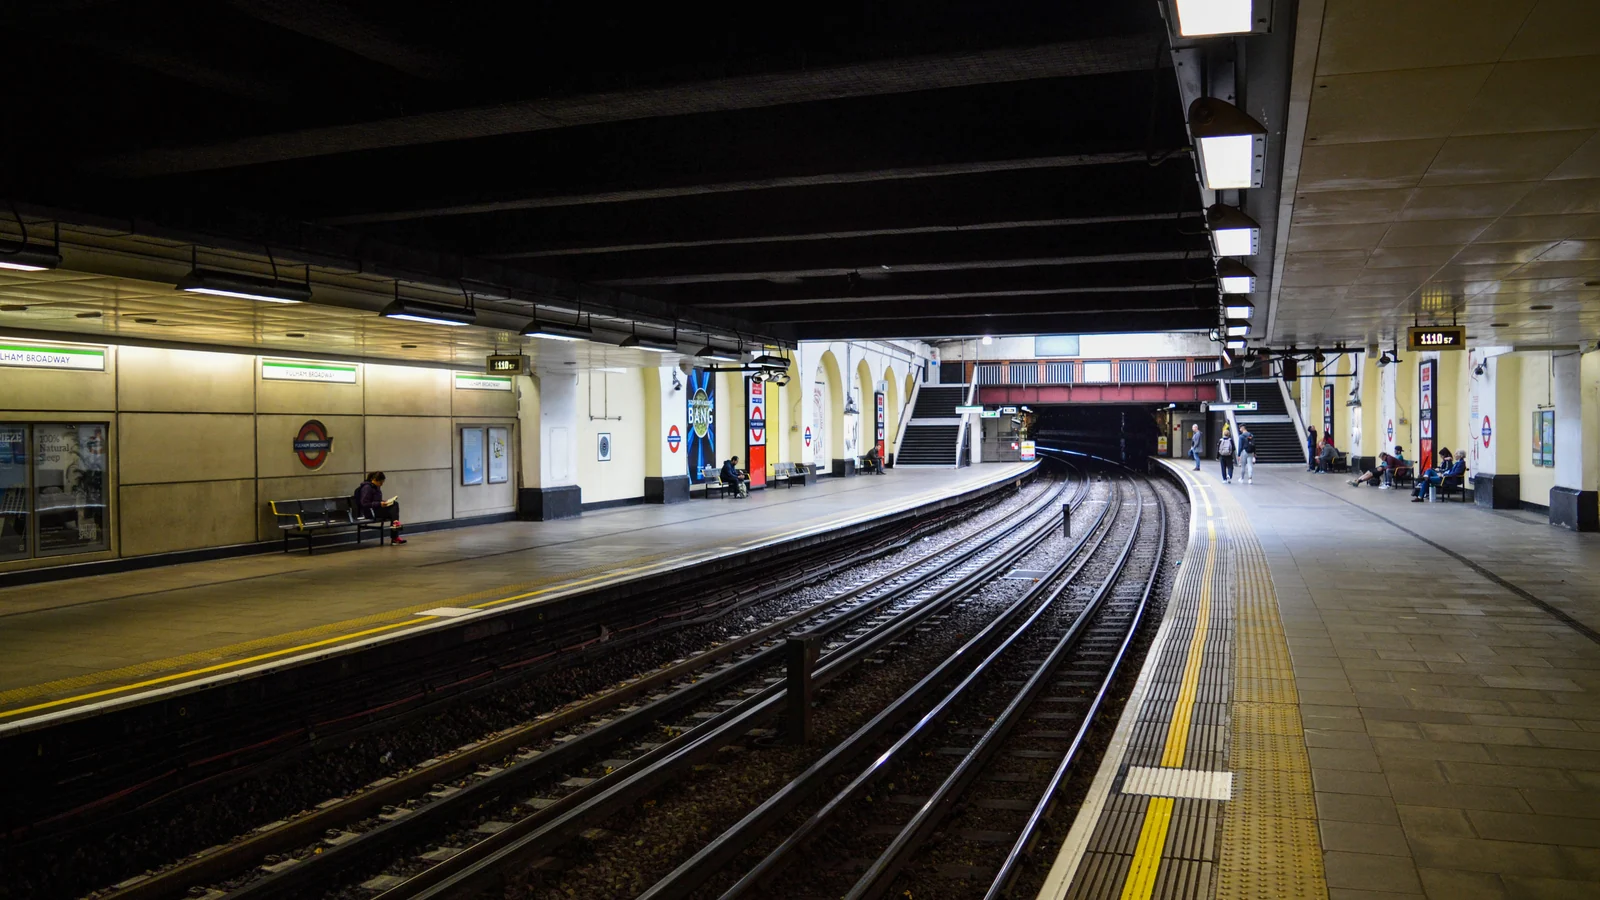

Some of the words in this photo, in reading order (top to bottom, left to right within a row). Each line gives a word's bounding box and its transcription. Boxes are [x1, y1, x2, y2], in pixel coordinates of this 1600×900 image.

[1421, 334, 1442, 344] 1110
[26, 354, 70, 364] BROADWAY
[688, 408, 713, 424] BANG
[40, 434, 60, 442] 100%
[40, 444, 69, 452] Natural
[40, 454, 60, 462] Seep
